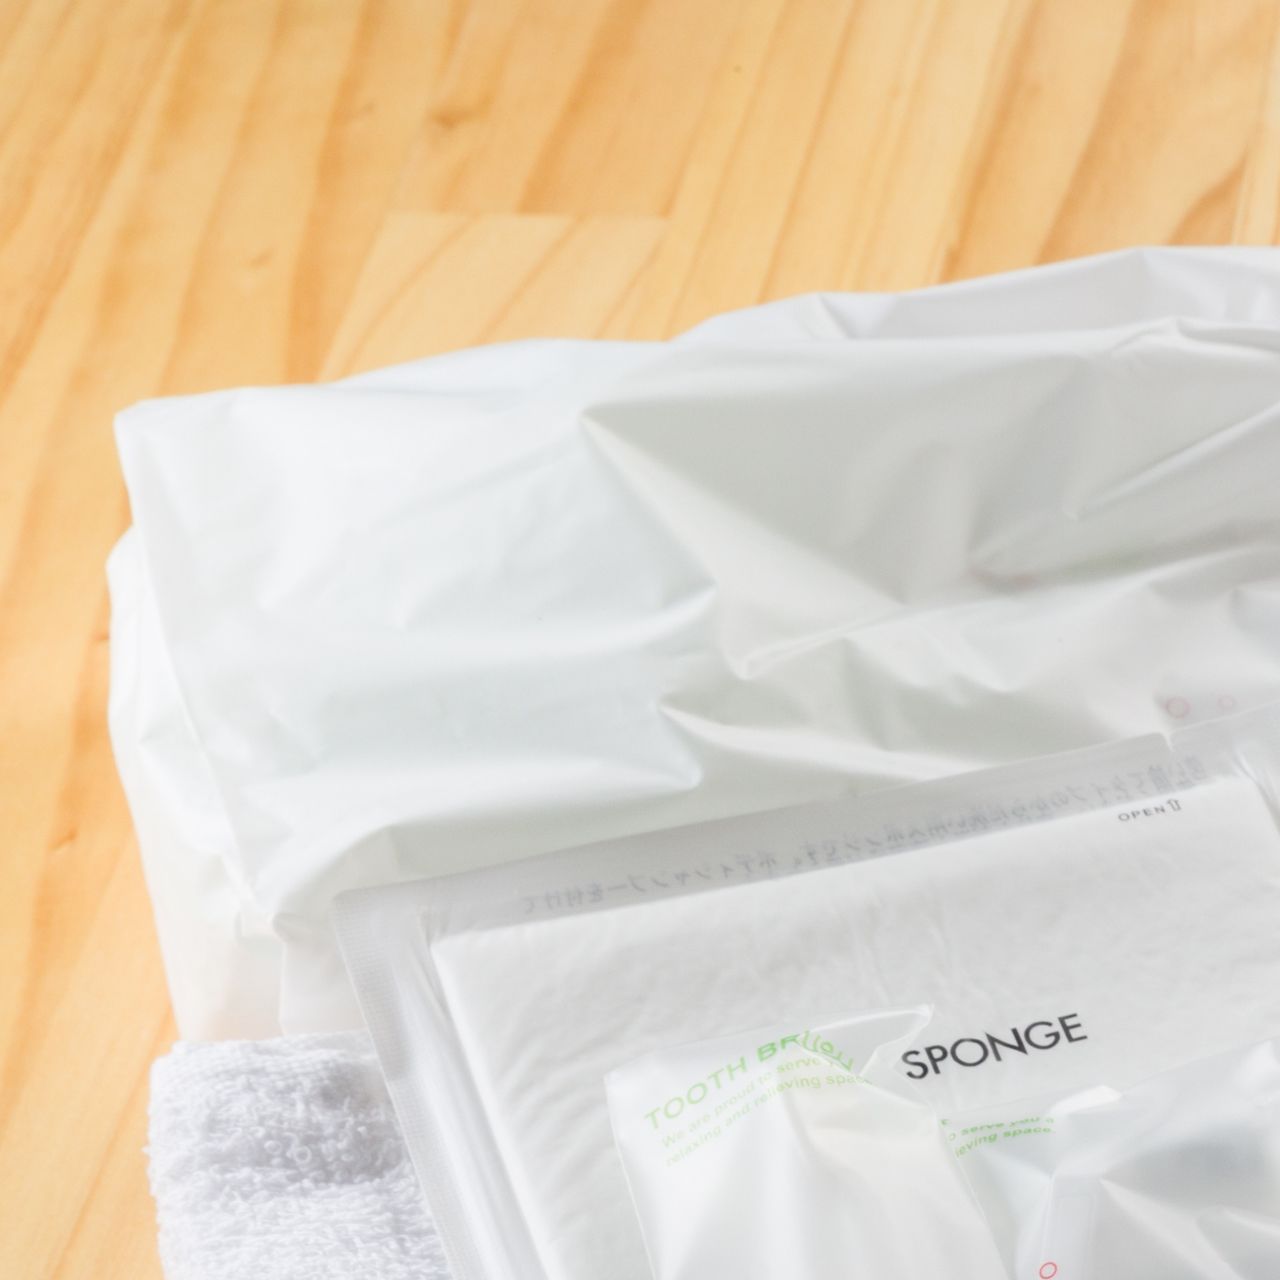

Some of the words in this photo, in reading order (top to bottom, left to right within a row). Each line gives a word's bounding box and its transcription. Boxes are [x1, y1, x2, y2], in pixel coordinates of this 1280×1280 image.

[1118, 805, 1165, 821] OPEN
[902, 1013, 1087, 1079] SPONGE
[645, 1056, 748, 1129] TOOTH
